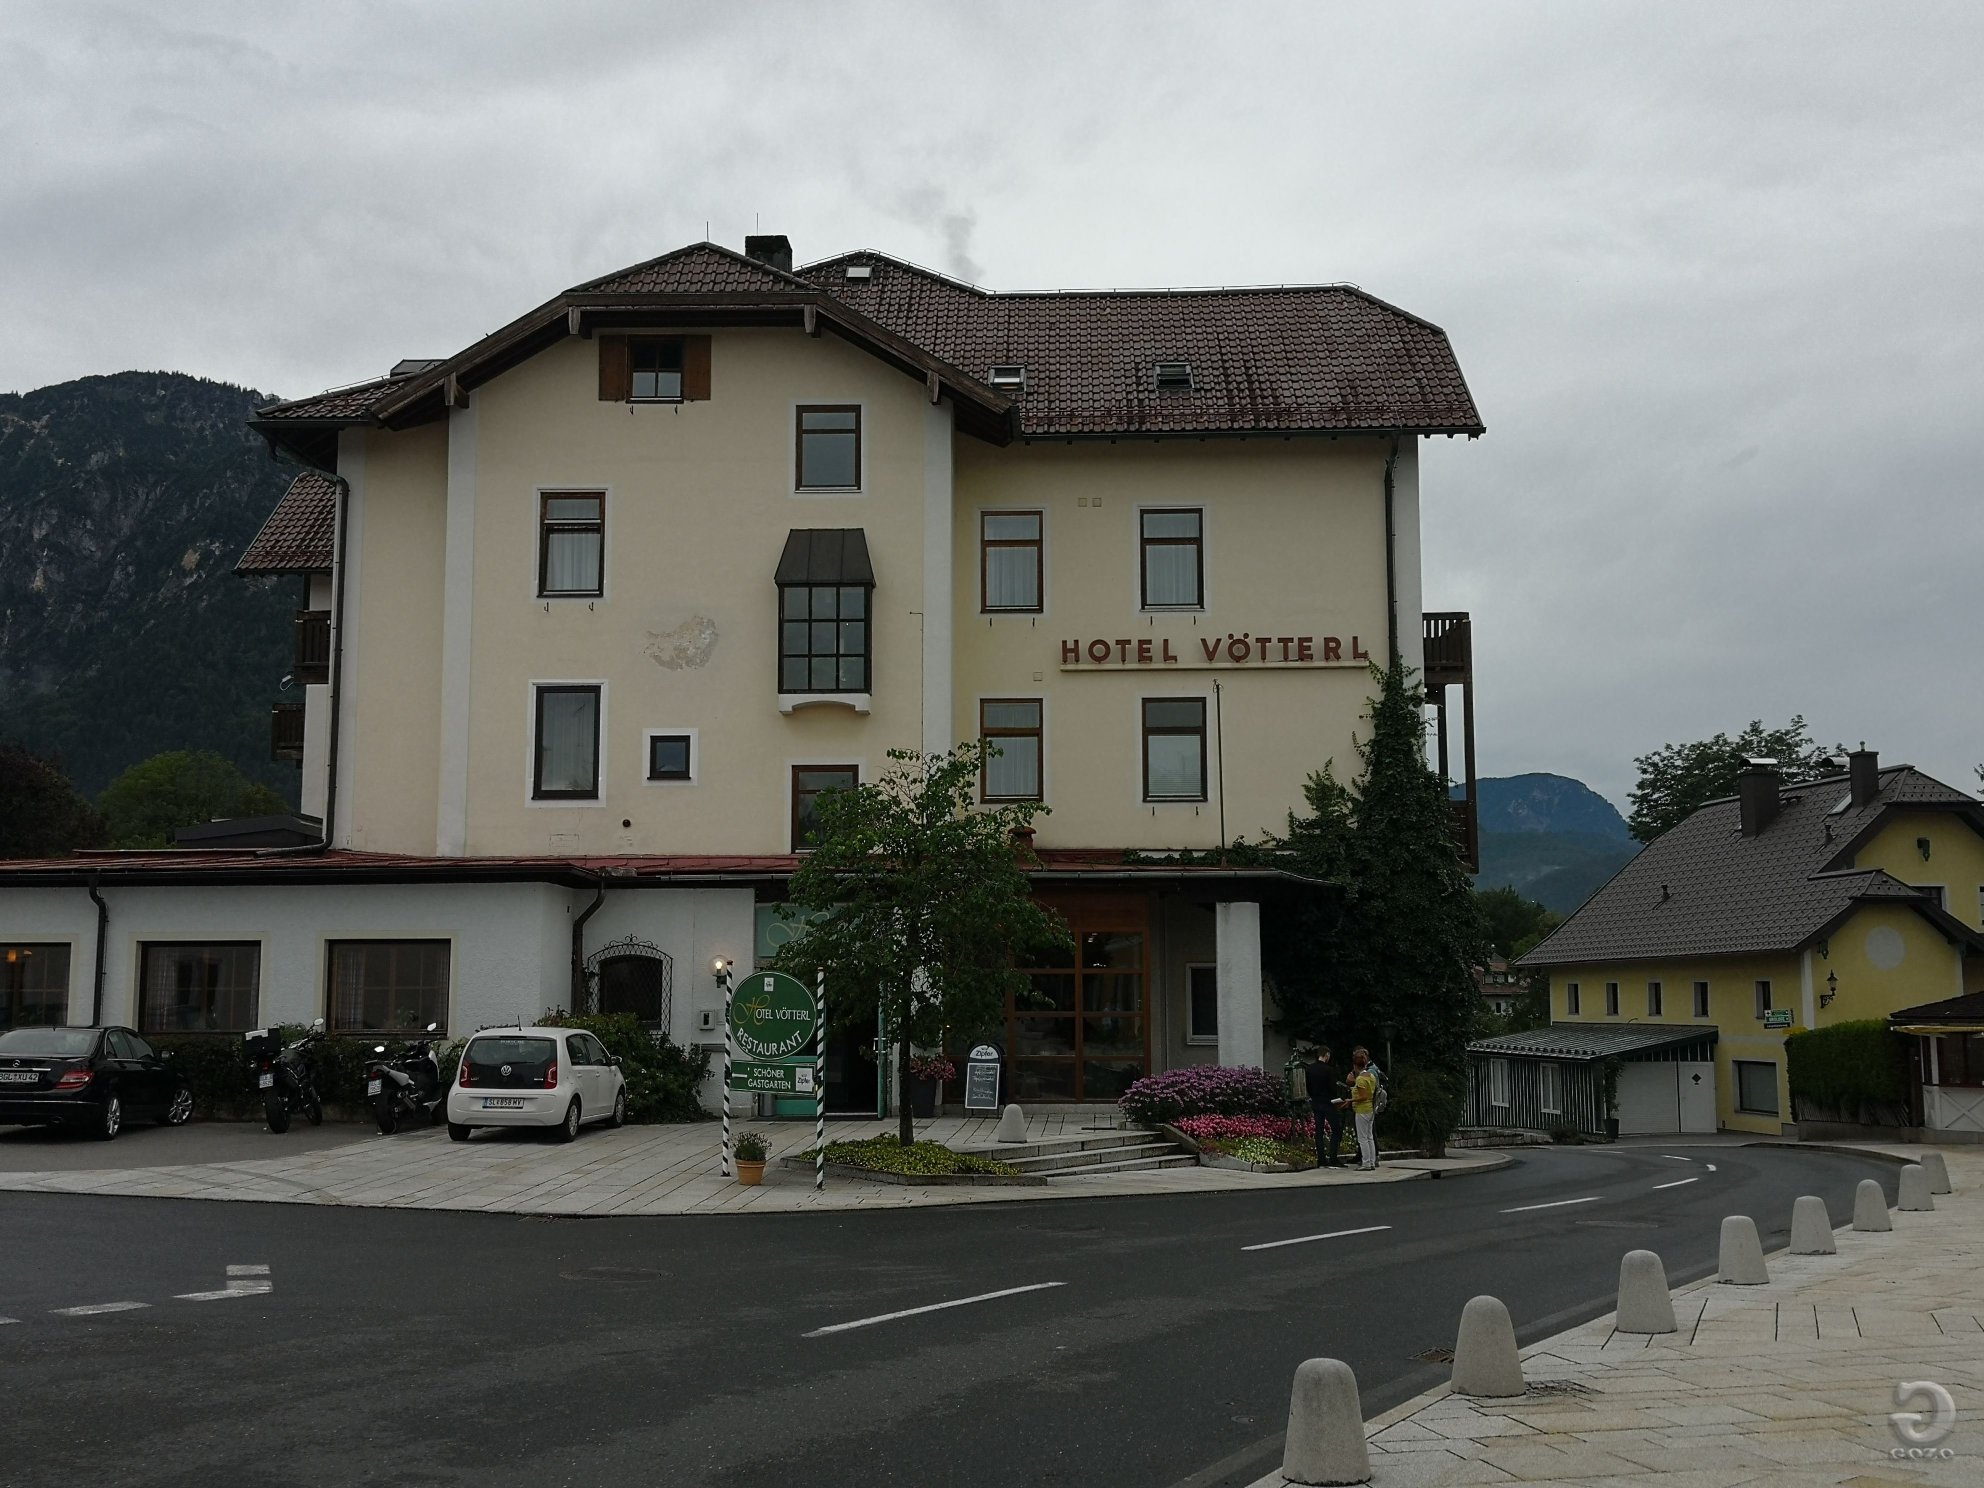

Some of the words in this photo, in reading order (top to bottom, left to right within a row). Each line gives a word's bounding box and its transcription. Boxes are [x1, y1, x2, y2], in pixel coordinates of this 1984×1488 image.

[1061, 638, 1178, 663] HOTEL
[1200, 632, 1369, 662] VÖTTERL
[775, 1006, 811, 1021] VÖTTERL
[737, 1028, 802, 1055] RESTAURANT
[753, 1067, 784, 1078] SCHÖNER
[747, 1079, 791, 1090] GASTGARTEN
